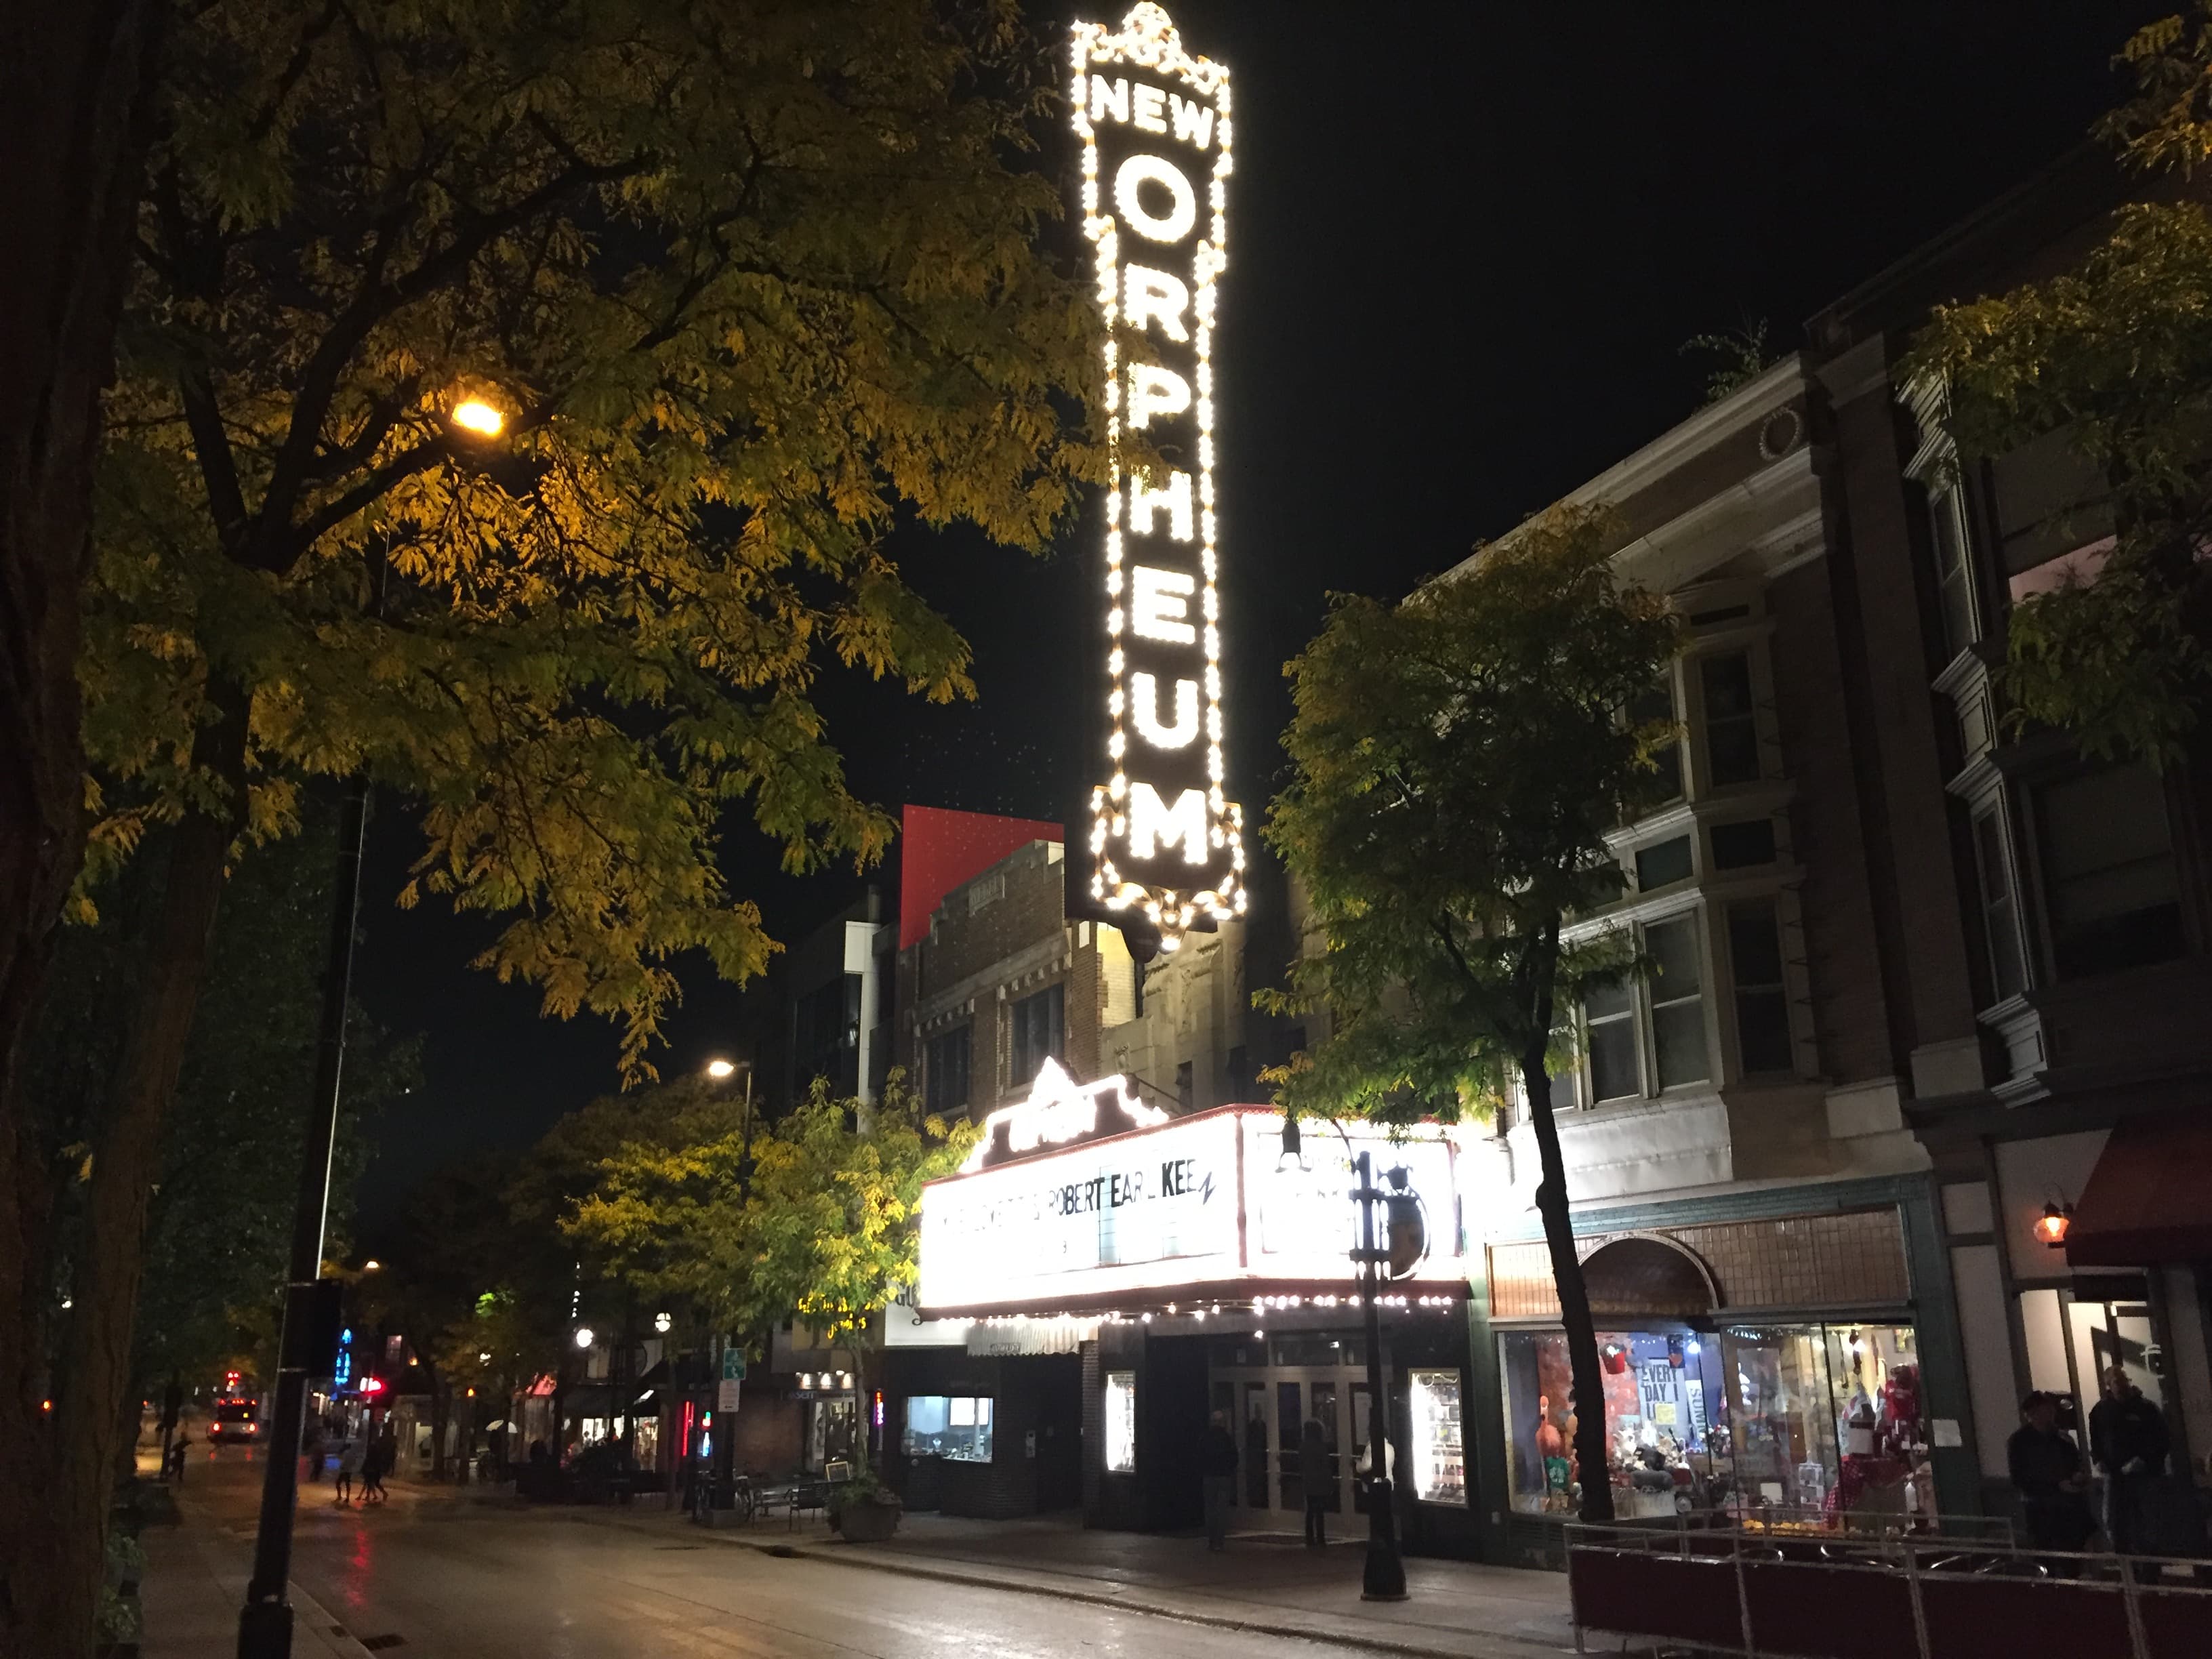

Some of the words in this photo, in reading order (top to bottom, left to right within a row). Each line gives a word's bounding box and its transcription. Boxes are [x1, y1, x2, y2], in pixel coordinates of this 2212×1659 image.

[1090, 73, 1214, 150] NEW
[1113, 154, 1208, 865] ORPHEUM
[1641, 1364, 1677, 1382] EVERY
[1644, 1383, 1666, 1401] DAY
[1673, 1383, 1679, 1401] I
